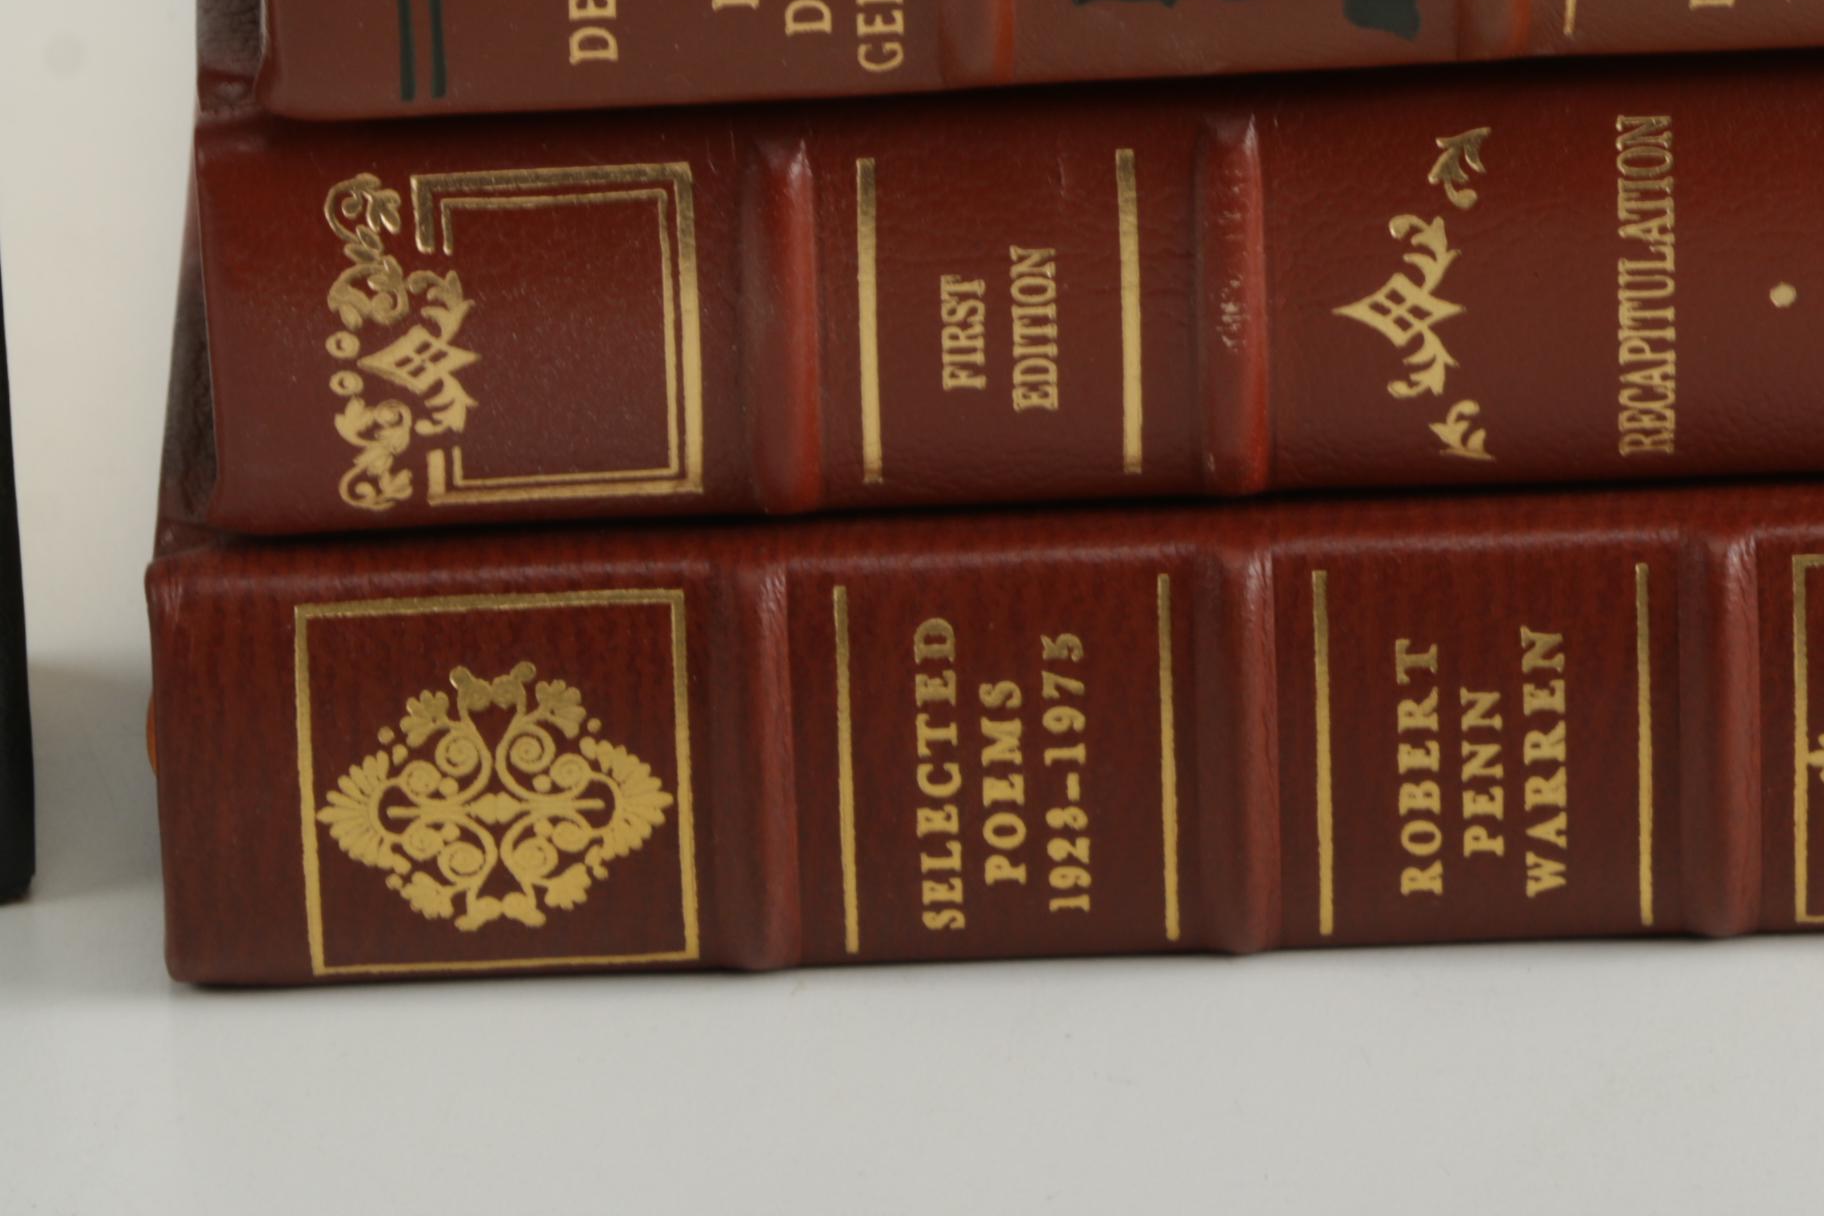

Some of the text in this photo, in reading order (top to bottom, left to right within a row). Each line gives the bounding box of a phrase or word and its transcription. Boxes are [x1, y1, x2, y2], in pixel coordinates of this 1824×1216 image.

[939, 274, 987, 391] FIRST
[1009, 245, 1059, 412] EDITION
[1615, 114, 1677, 456] RECAPITULATION
[913, 617, 966, 930] SELECTED
[978, 680, 1027, 885] POEMS
[1394, 638, 1444, 896] ROBERT
[1459, 686, 1505, 858] PENN
[1519, 625, 1568, 898] WARREN
